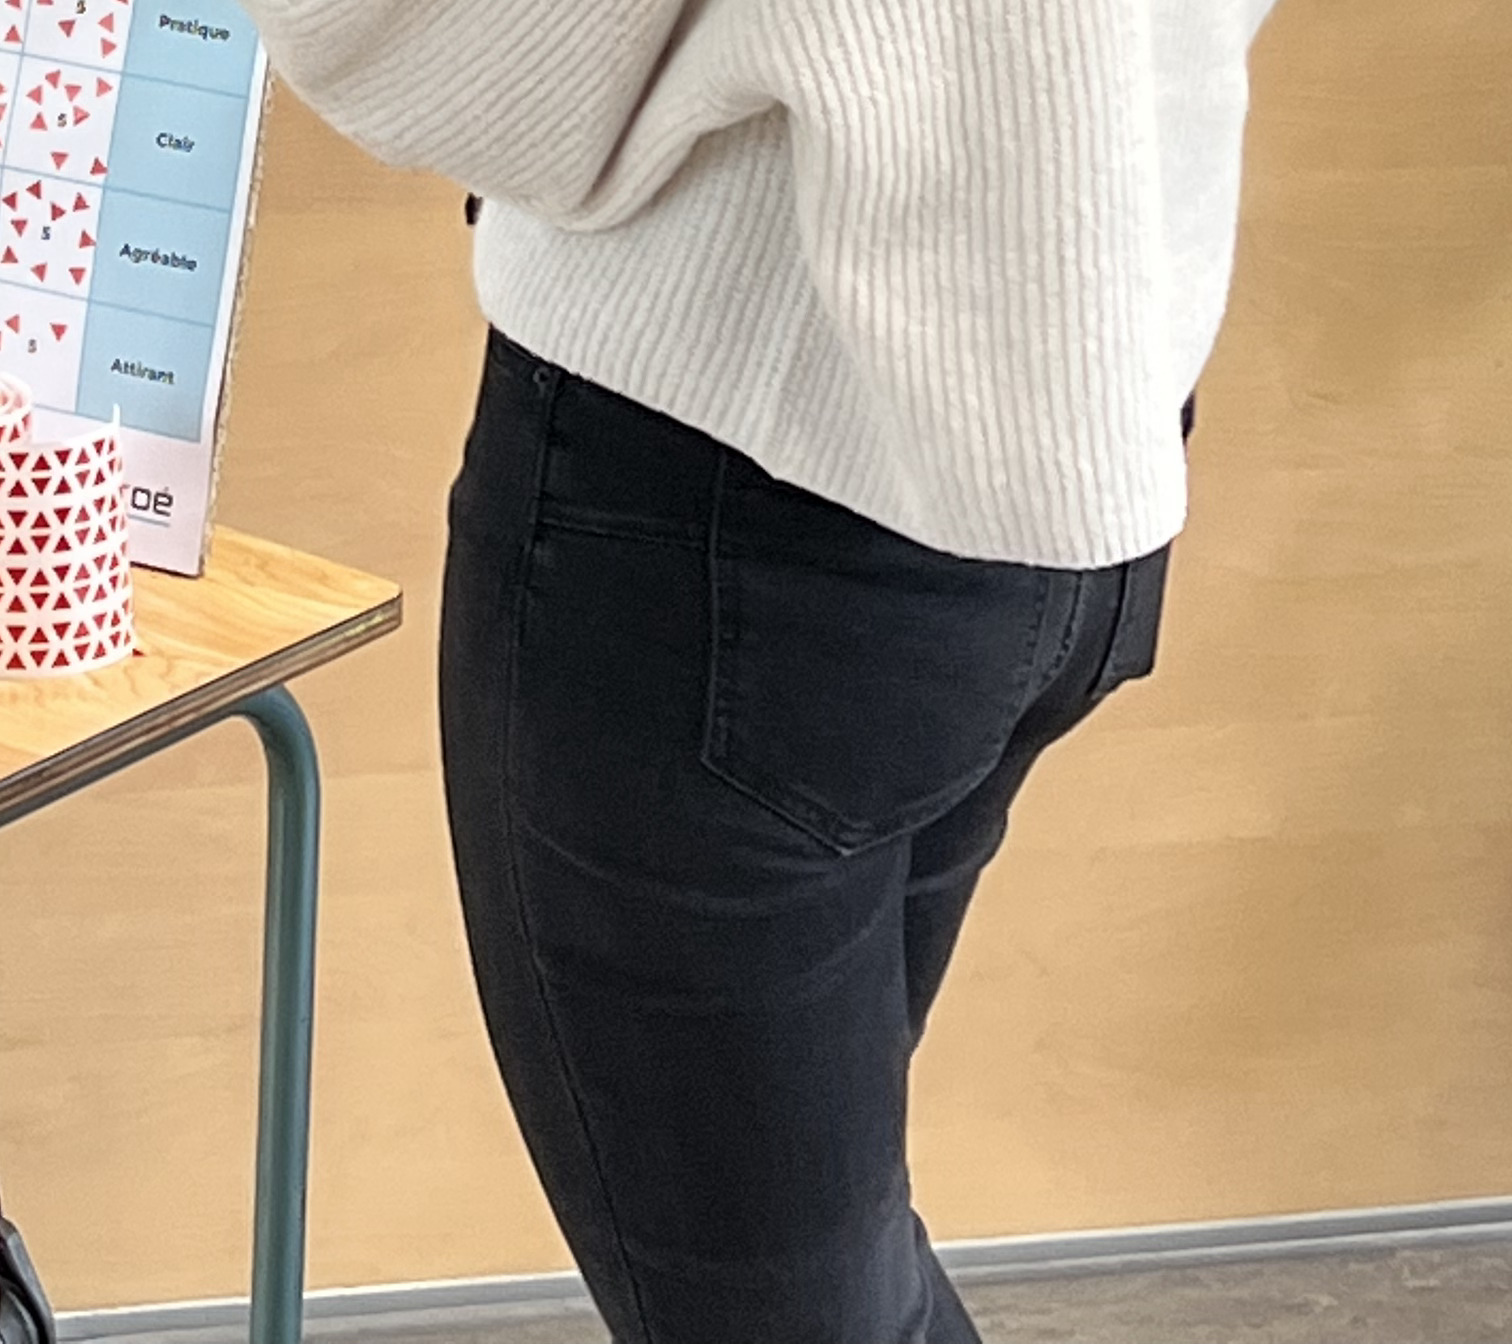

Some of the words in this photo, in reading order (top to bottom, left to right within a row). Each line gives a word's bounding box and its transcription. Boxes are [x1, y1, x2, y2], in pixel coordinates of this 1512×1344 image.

[159, 14, 231, 42] Pratique
[57, 113, 68, 128] 5
[155, 132, 196, 154] Clair
[40, 226, 51, 241] 5
[118, 243, 198, 272] Agréable
[27, 338, 38, 354] 5
[110, 358, 176, 386] Attirant
